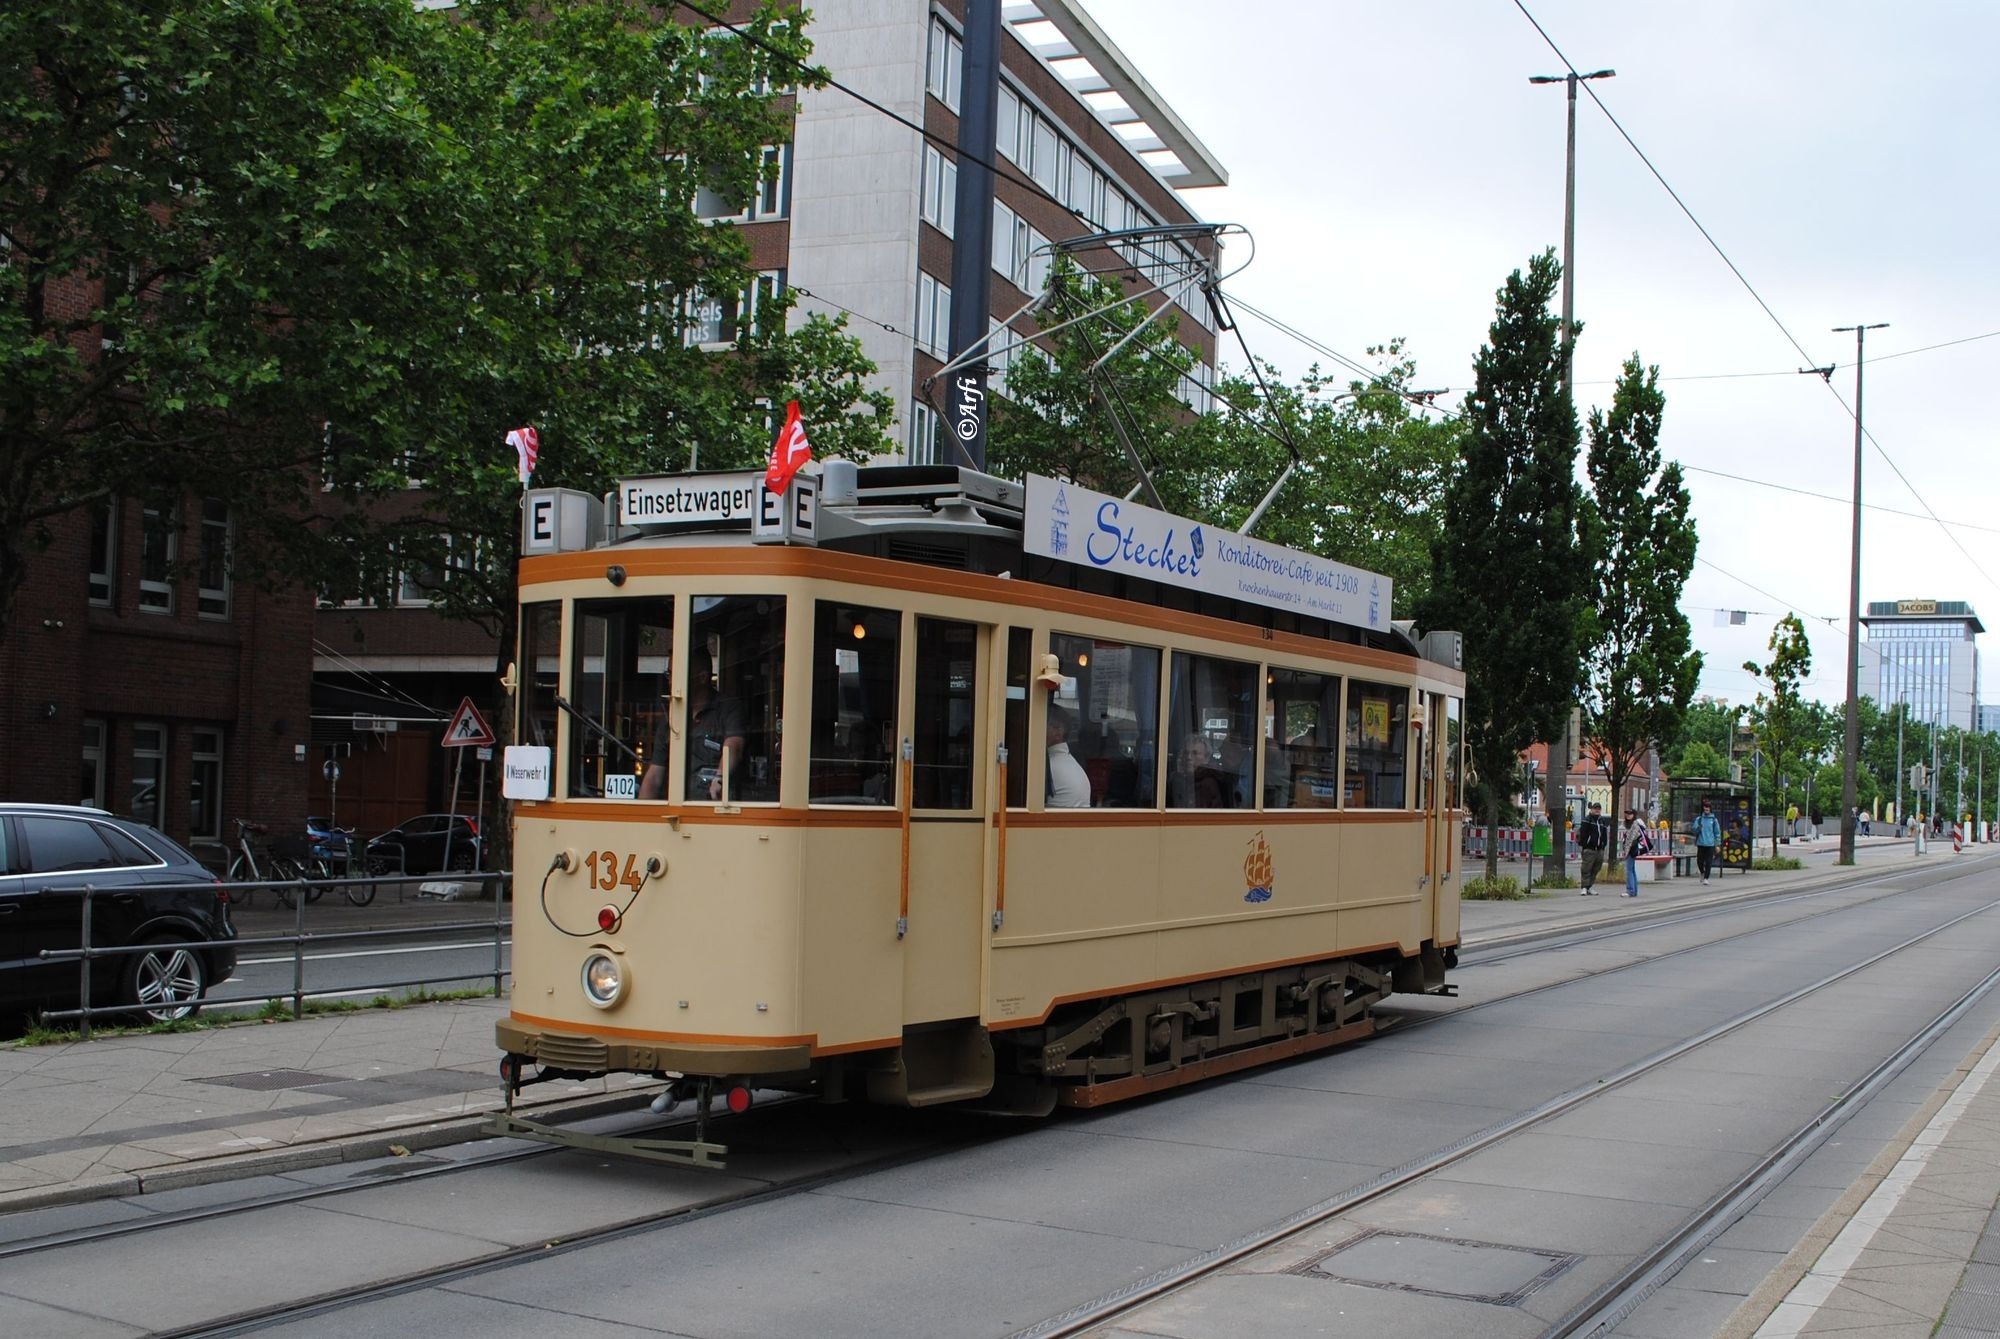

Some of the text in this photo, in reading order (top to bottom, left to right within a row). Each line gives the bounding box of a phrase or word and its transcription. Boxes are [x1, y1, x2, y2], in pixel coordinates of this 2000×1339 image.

[534, 501, 552, 540] E
[628, 488, 753, 518] Einsetzwagen
[761, 486, 780, 527] E
[796, 486, 813, 530] E
[1087, 501, 1201, 577] Stecker
[1315, 570, 1334, 588] seit
[1335, 573, 1359, 594] 1908
[1900, 604, 1934, 612] JACOBS
[606, 778, 634, 795] 4102
[584, 850, 642, 893] 134
